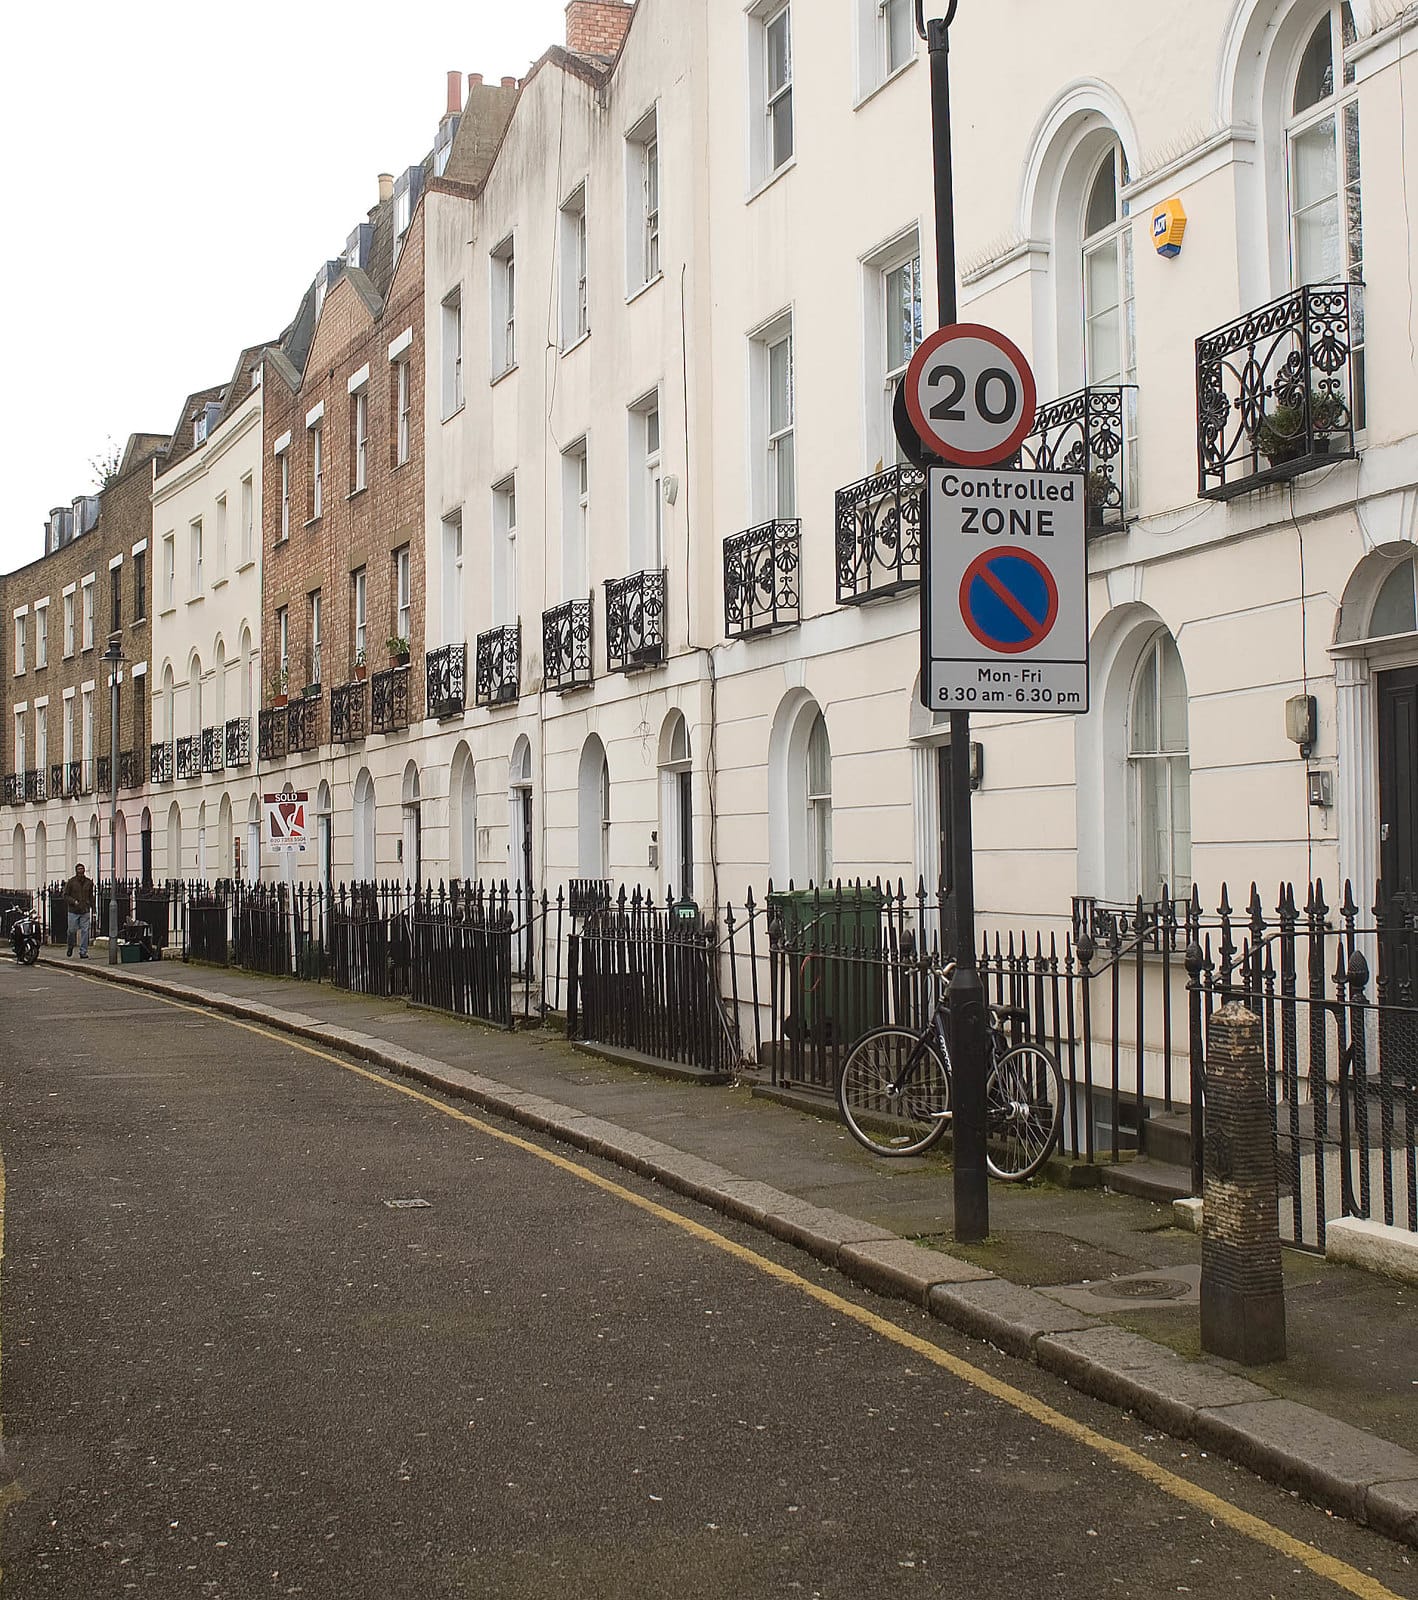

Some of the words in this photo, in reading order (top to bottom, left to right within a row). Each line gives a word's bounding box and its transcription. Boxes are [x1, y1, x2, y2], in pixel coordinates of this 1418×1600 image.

[927, 364, 1017, 425] 20
[941, 474, 1074, 501] Controlled
[961, 507, 1054, 536] ZONE
[938, 687, 977, 701] 8.30
[1057, 692, 1080, 704] pm
[275, 793, 298, 801] SOLD
